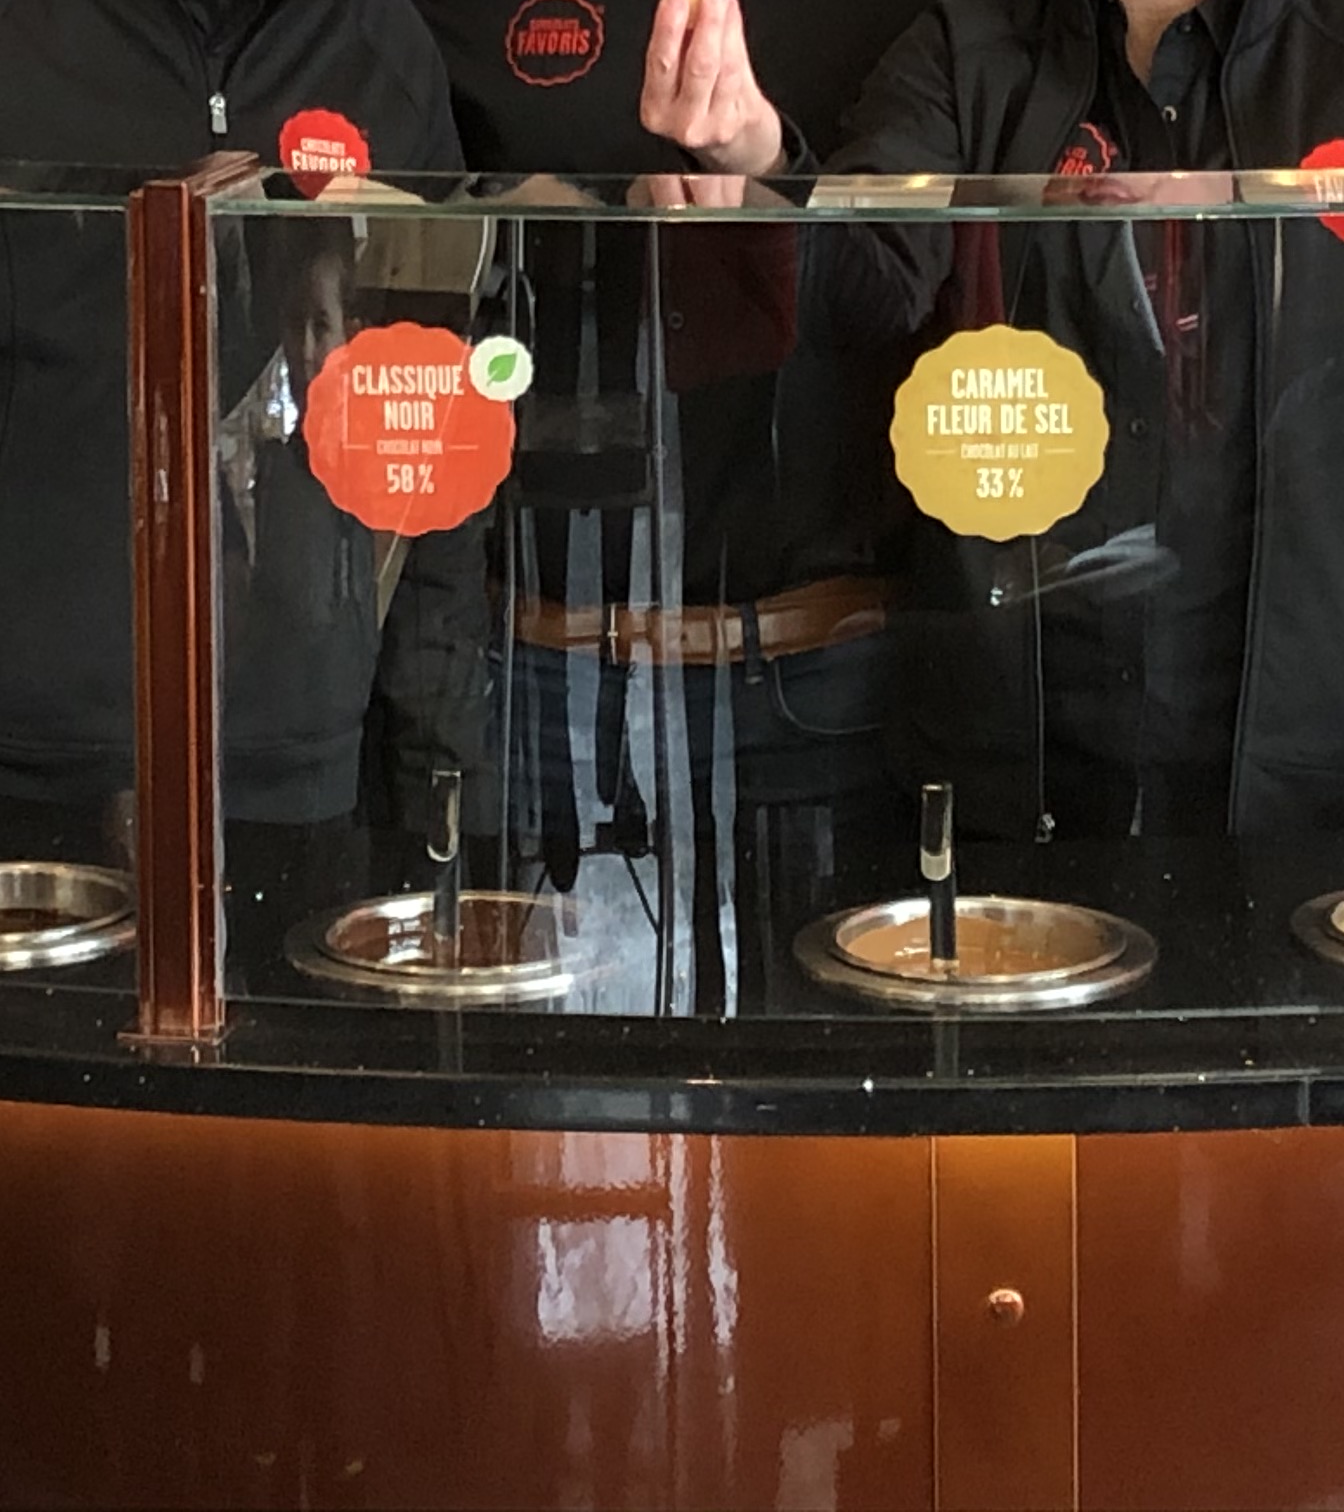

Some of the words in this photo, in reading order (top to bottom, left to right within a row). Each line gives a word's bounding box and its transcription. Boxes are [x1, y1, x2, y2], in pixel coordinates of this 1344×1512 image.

[516, 29, 591, 56] FAVORIS
[352, 365, 465, 400] CLASSIQUE
[951, 368, 1049, 399] CARAMEL
[384, 400, 435, 430] NOIR
[927, 404, 992, 435] FLEUR
[1000, 403, 1028, 434] DE
[1034, 403, 1074, 434] SEL
